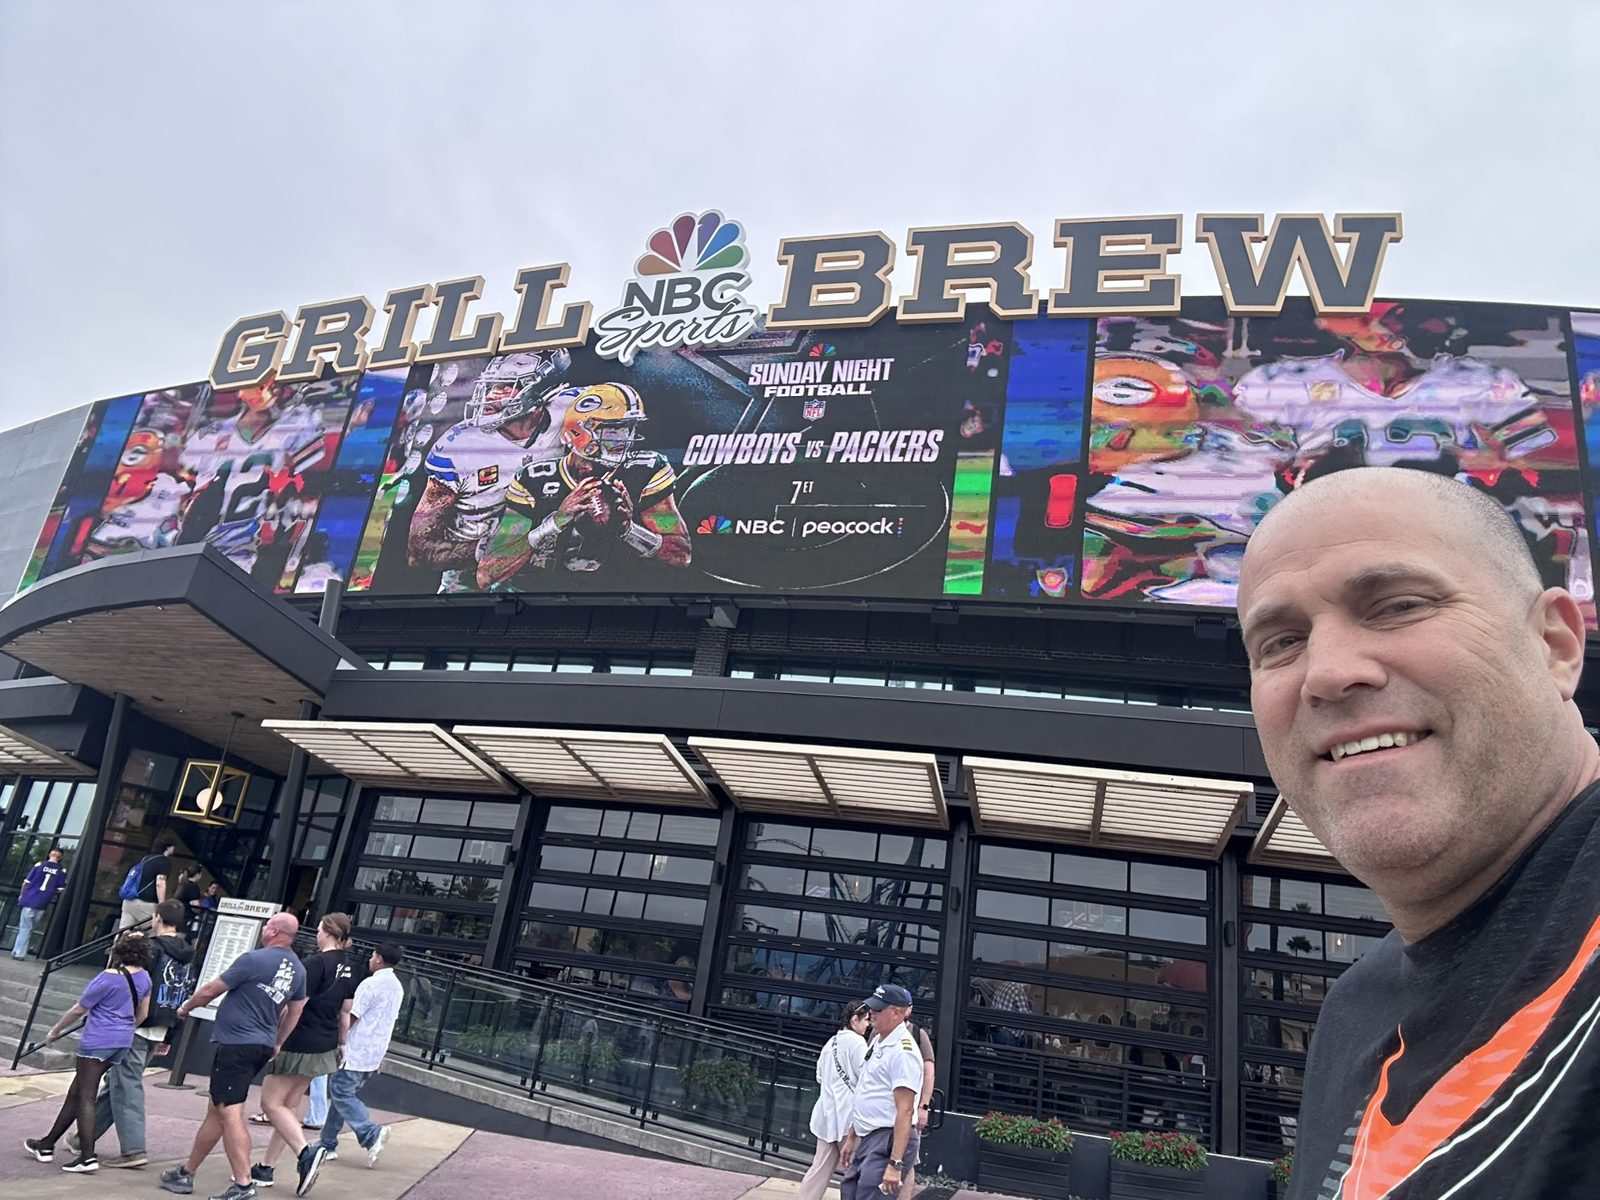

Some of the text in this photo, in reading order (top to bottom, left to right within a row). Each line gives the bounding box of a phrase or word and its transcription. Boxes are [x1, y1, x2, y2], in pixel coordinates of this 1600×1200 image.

[766, 213, 1403, 330] BREW
[622, 272, 745, 318] NBC
[209, 262, 593, 391] GRILL
[599, 302, 753, 358] Sports
[748, 358, 894, 386] SUNDAY NIGHT
[764, 383, 872, 397] FOOTBALL
[682, 432, 801, 466] COWBOYS
[826, 429, 944, 463] PACKERS
[735, 519, 785, 534] NBC
[802, 517, 893, 537] peacock
[40, 873, 51, 891] 1
[244, 904, 270, 913] BREW
